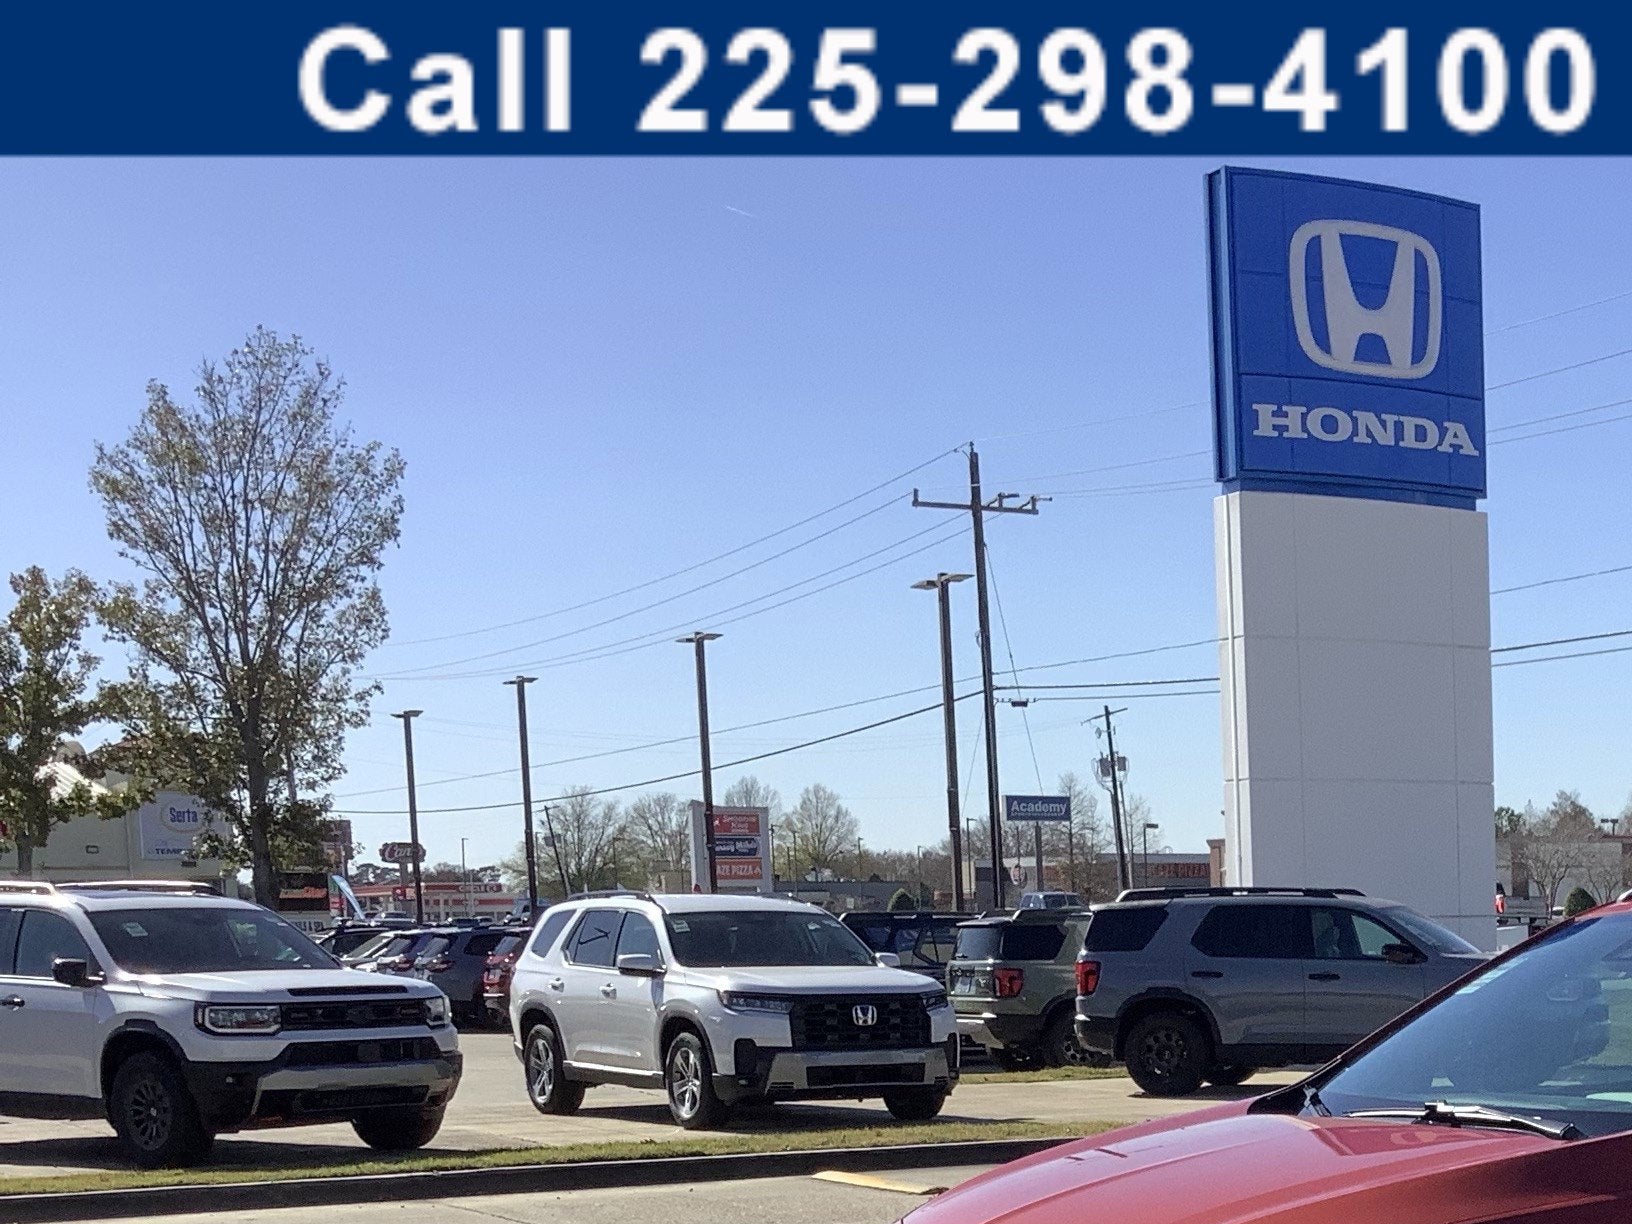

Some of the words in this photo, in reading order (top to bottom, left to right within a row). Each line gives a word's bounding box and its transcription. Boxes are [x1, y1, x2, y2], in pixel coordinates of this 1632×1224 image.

[1251, 403, 1480, 457] HONDA
[169, 806, 199, 823] Serta
[1010, 800, 1067, 817] Academy
[731, 864, 753, 876] PIZZA
